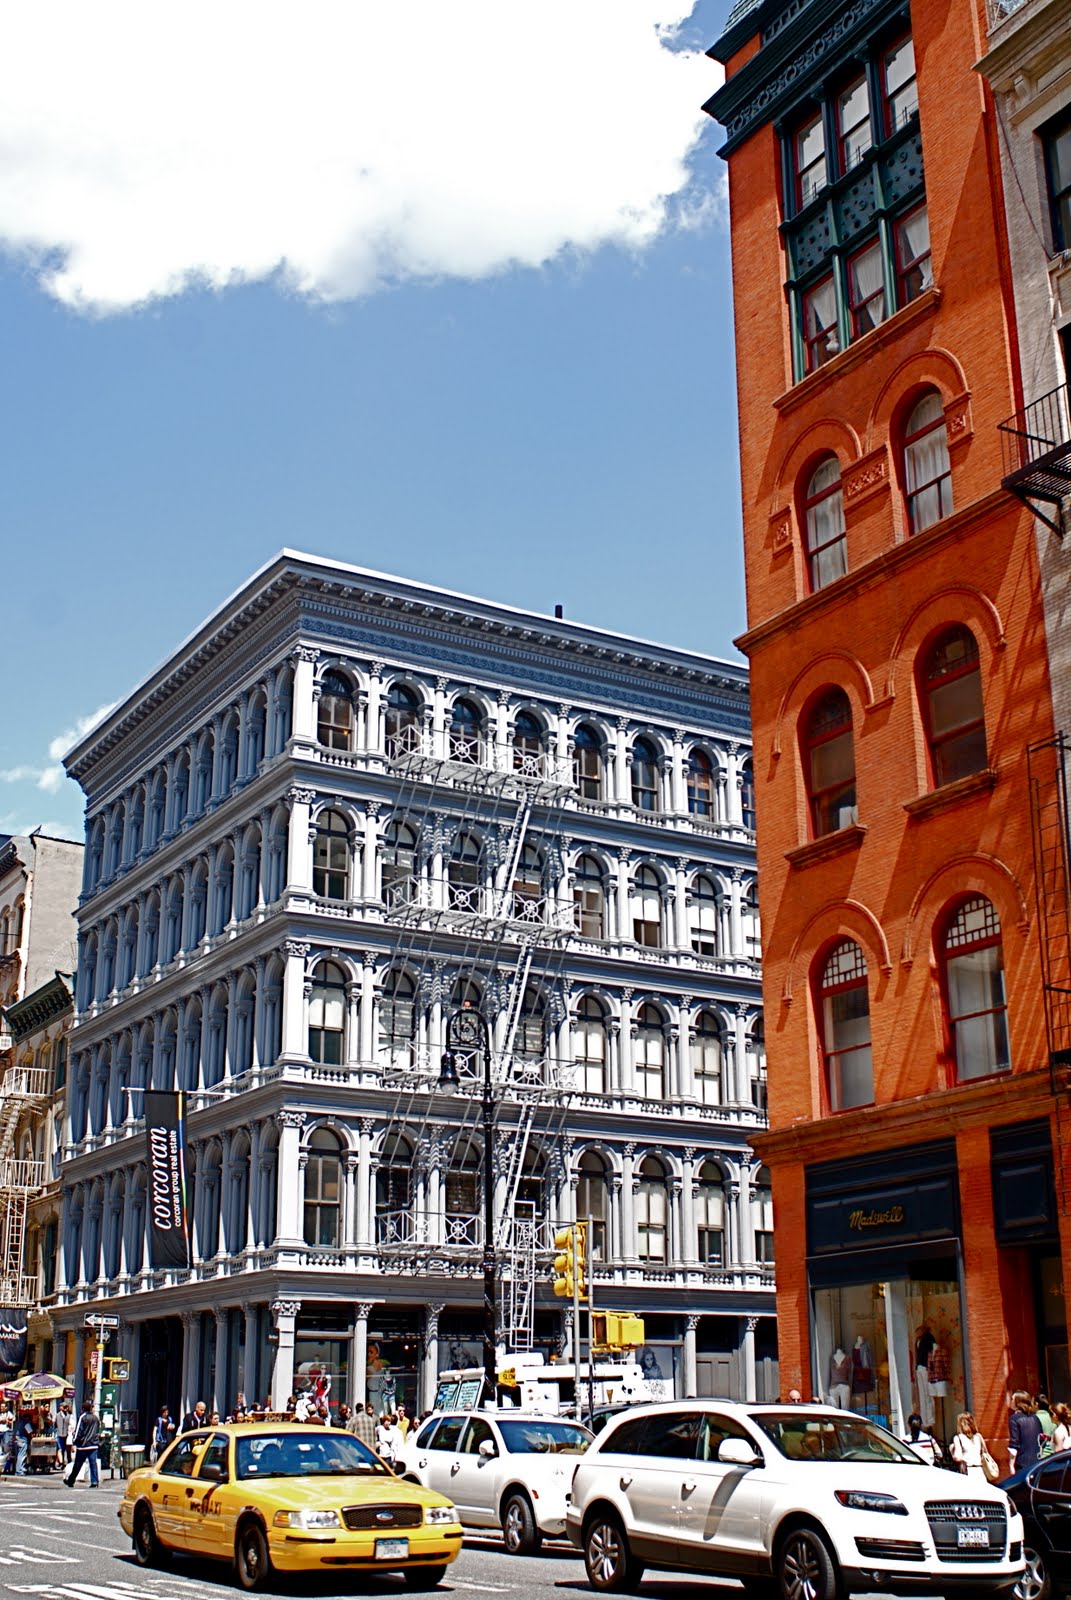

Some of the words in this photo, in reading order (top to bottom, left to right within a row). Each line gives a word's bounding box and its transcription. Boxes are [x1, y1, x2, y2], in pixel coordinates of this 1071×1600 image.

[169, 1130, 177, 1154] estate
[150, 1127, 172, 1230] corcoran
[172, 1171, 180, 1193] group
[173, 1195, 181, 1227] corcoran
[849, 1206, 903, 1231] Madewell
